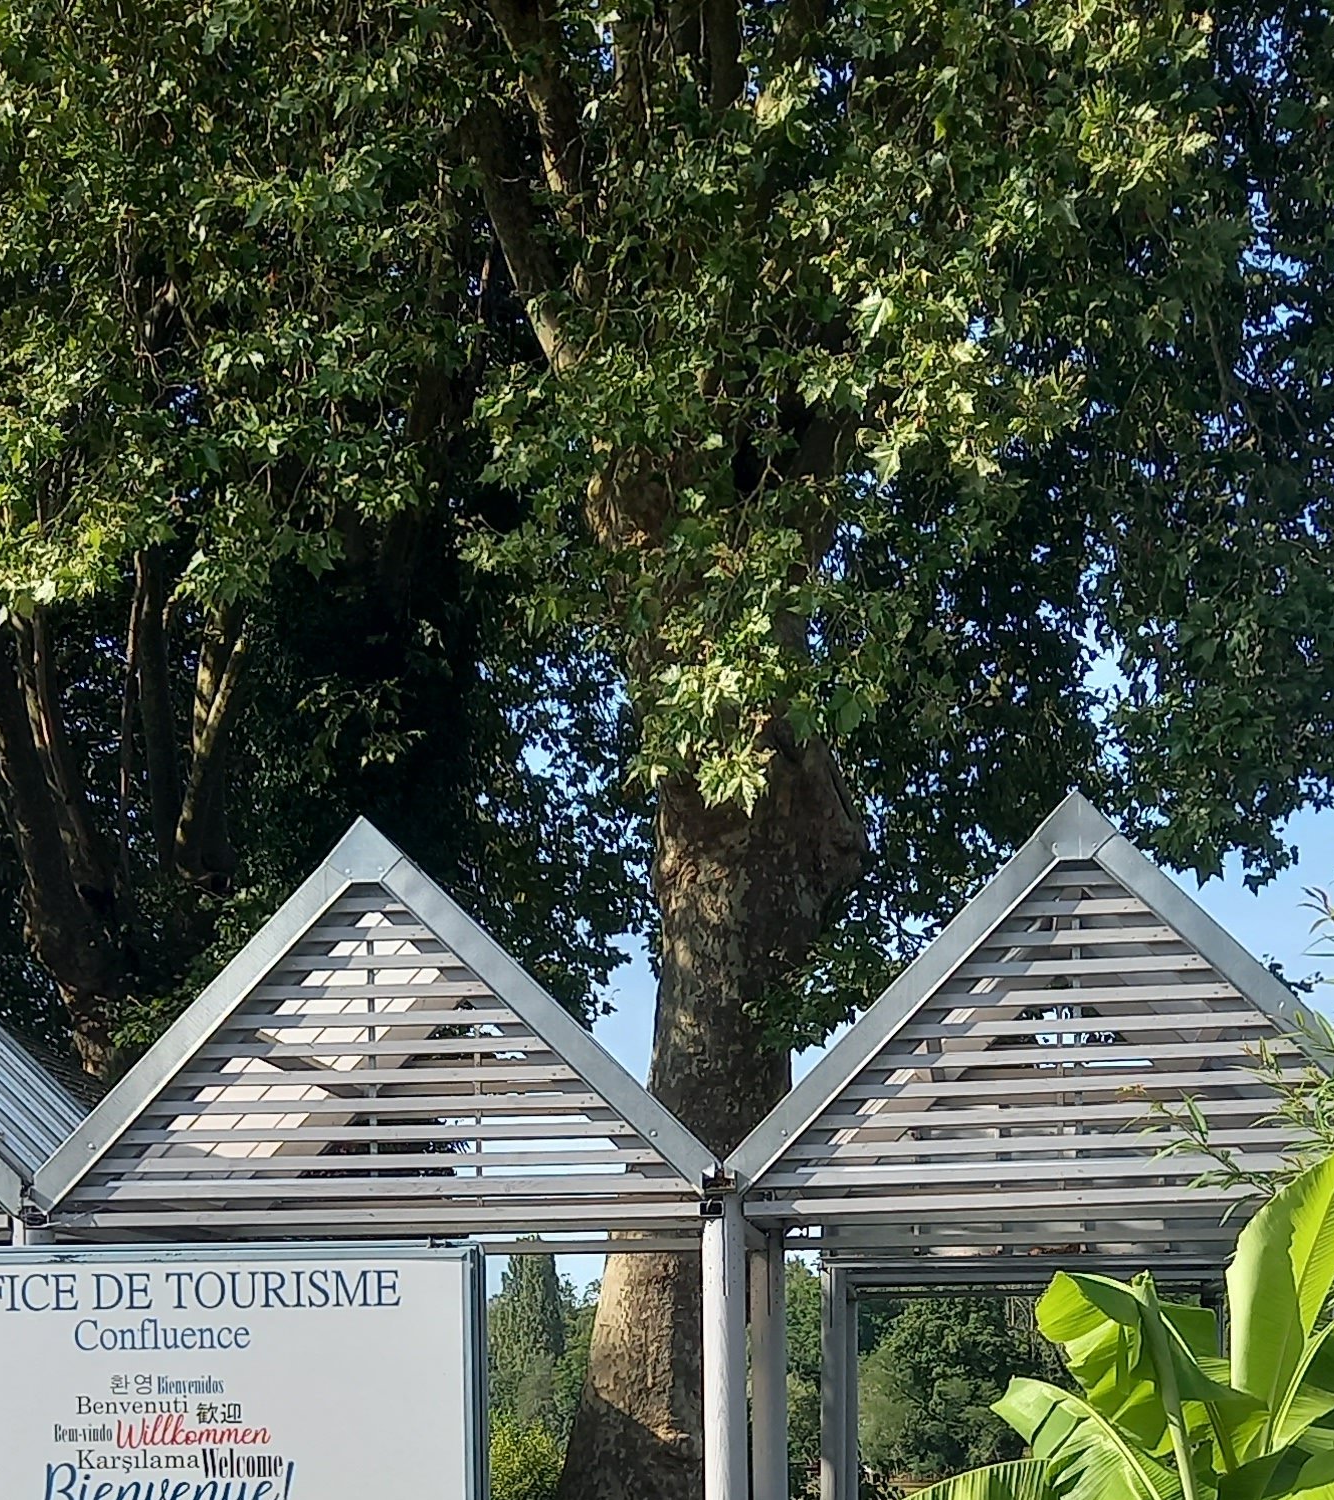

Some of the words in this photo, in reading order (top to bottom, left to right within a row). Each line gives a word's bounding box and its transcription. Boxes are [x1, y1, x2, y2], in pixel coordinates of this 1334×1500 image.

[92, 1272, 154, 1311] DE
[166, 1269, 403, 1310] TOURISME
[74, 1318, 251, 1351] Confluence
[157, 1375, 225, 1395] Bienvenidos
[75, 1395, 189, 1415] Benvenuti
[54, 1424, 113, 1443] Bem-vindo
[116, 1414, 271, 1449] Willkommen
[75, 1449, 199, 1473] Karşılama
[202, 1448, 283, 1478] Welcome
